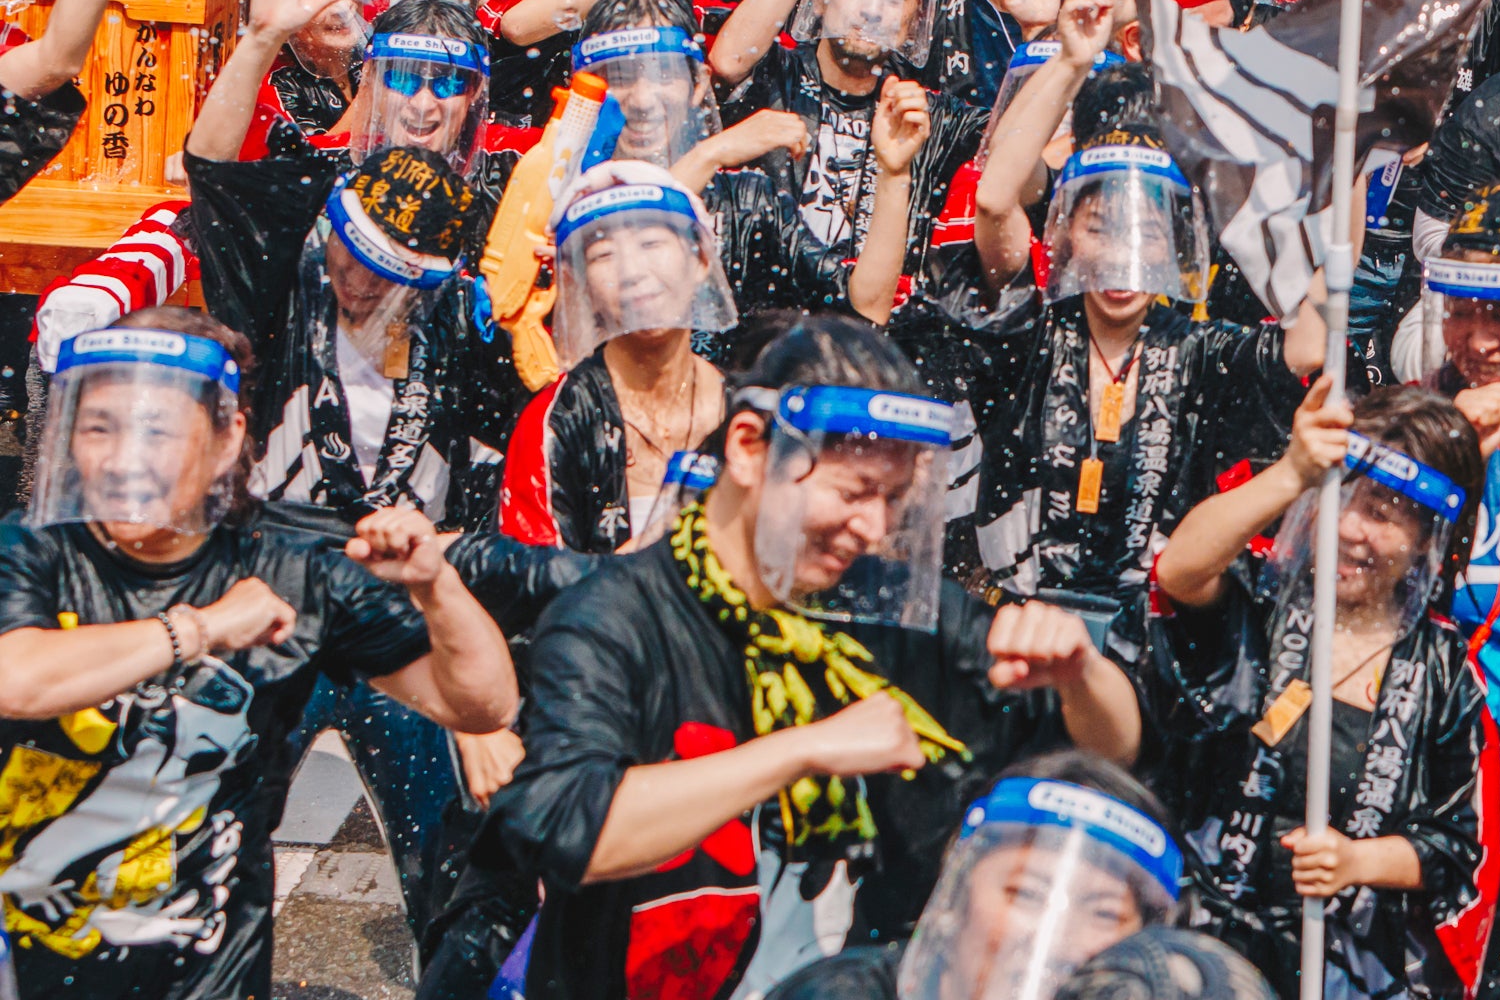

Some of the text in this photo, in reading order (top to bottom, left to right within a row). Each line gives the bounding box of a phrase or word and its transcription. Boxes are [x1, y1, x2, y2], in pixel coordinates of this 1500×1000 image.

[394, 37, 460, 52] Face Shield
[585, 32, 652, 51] Face Shield
[1031, 45, 1058, 55] Face
[135, 22, 158, 118] かんなわ
[101, 71, 131, 160] ゆの香
[609, 189, 655, 200] Shield
[1116, 345, 1179, 561] 別府八湯温泉道名
